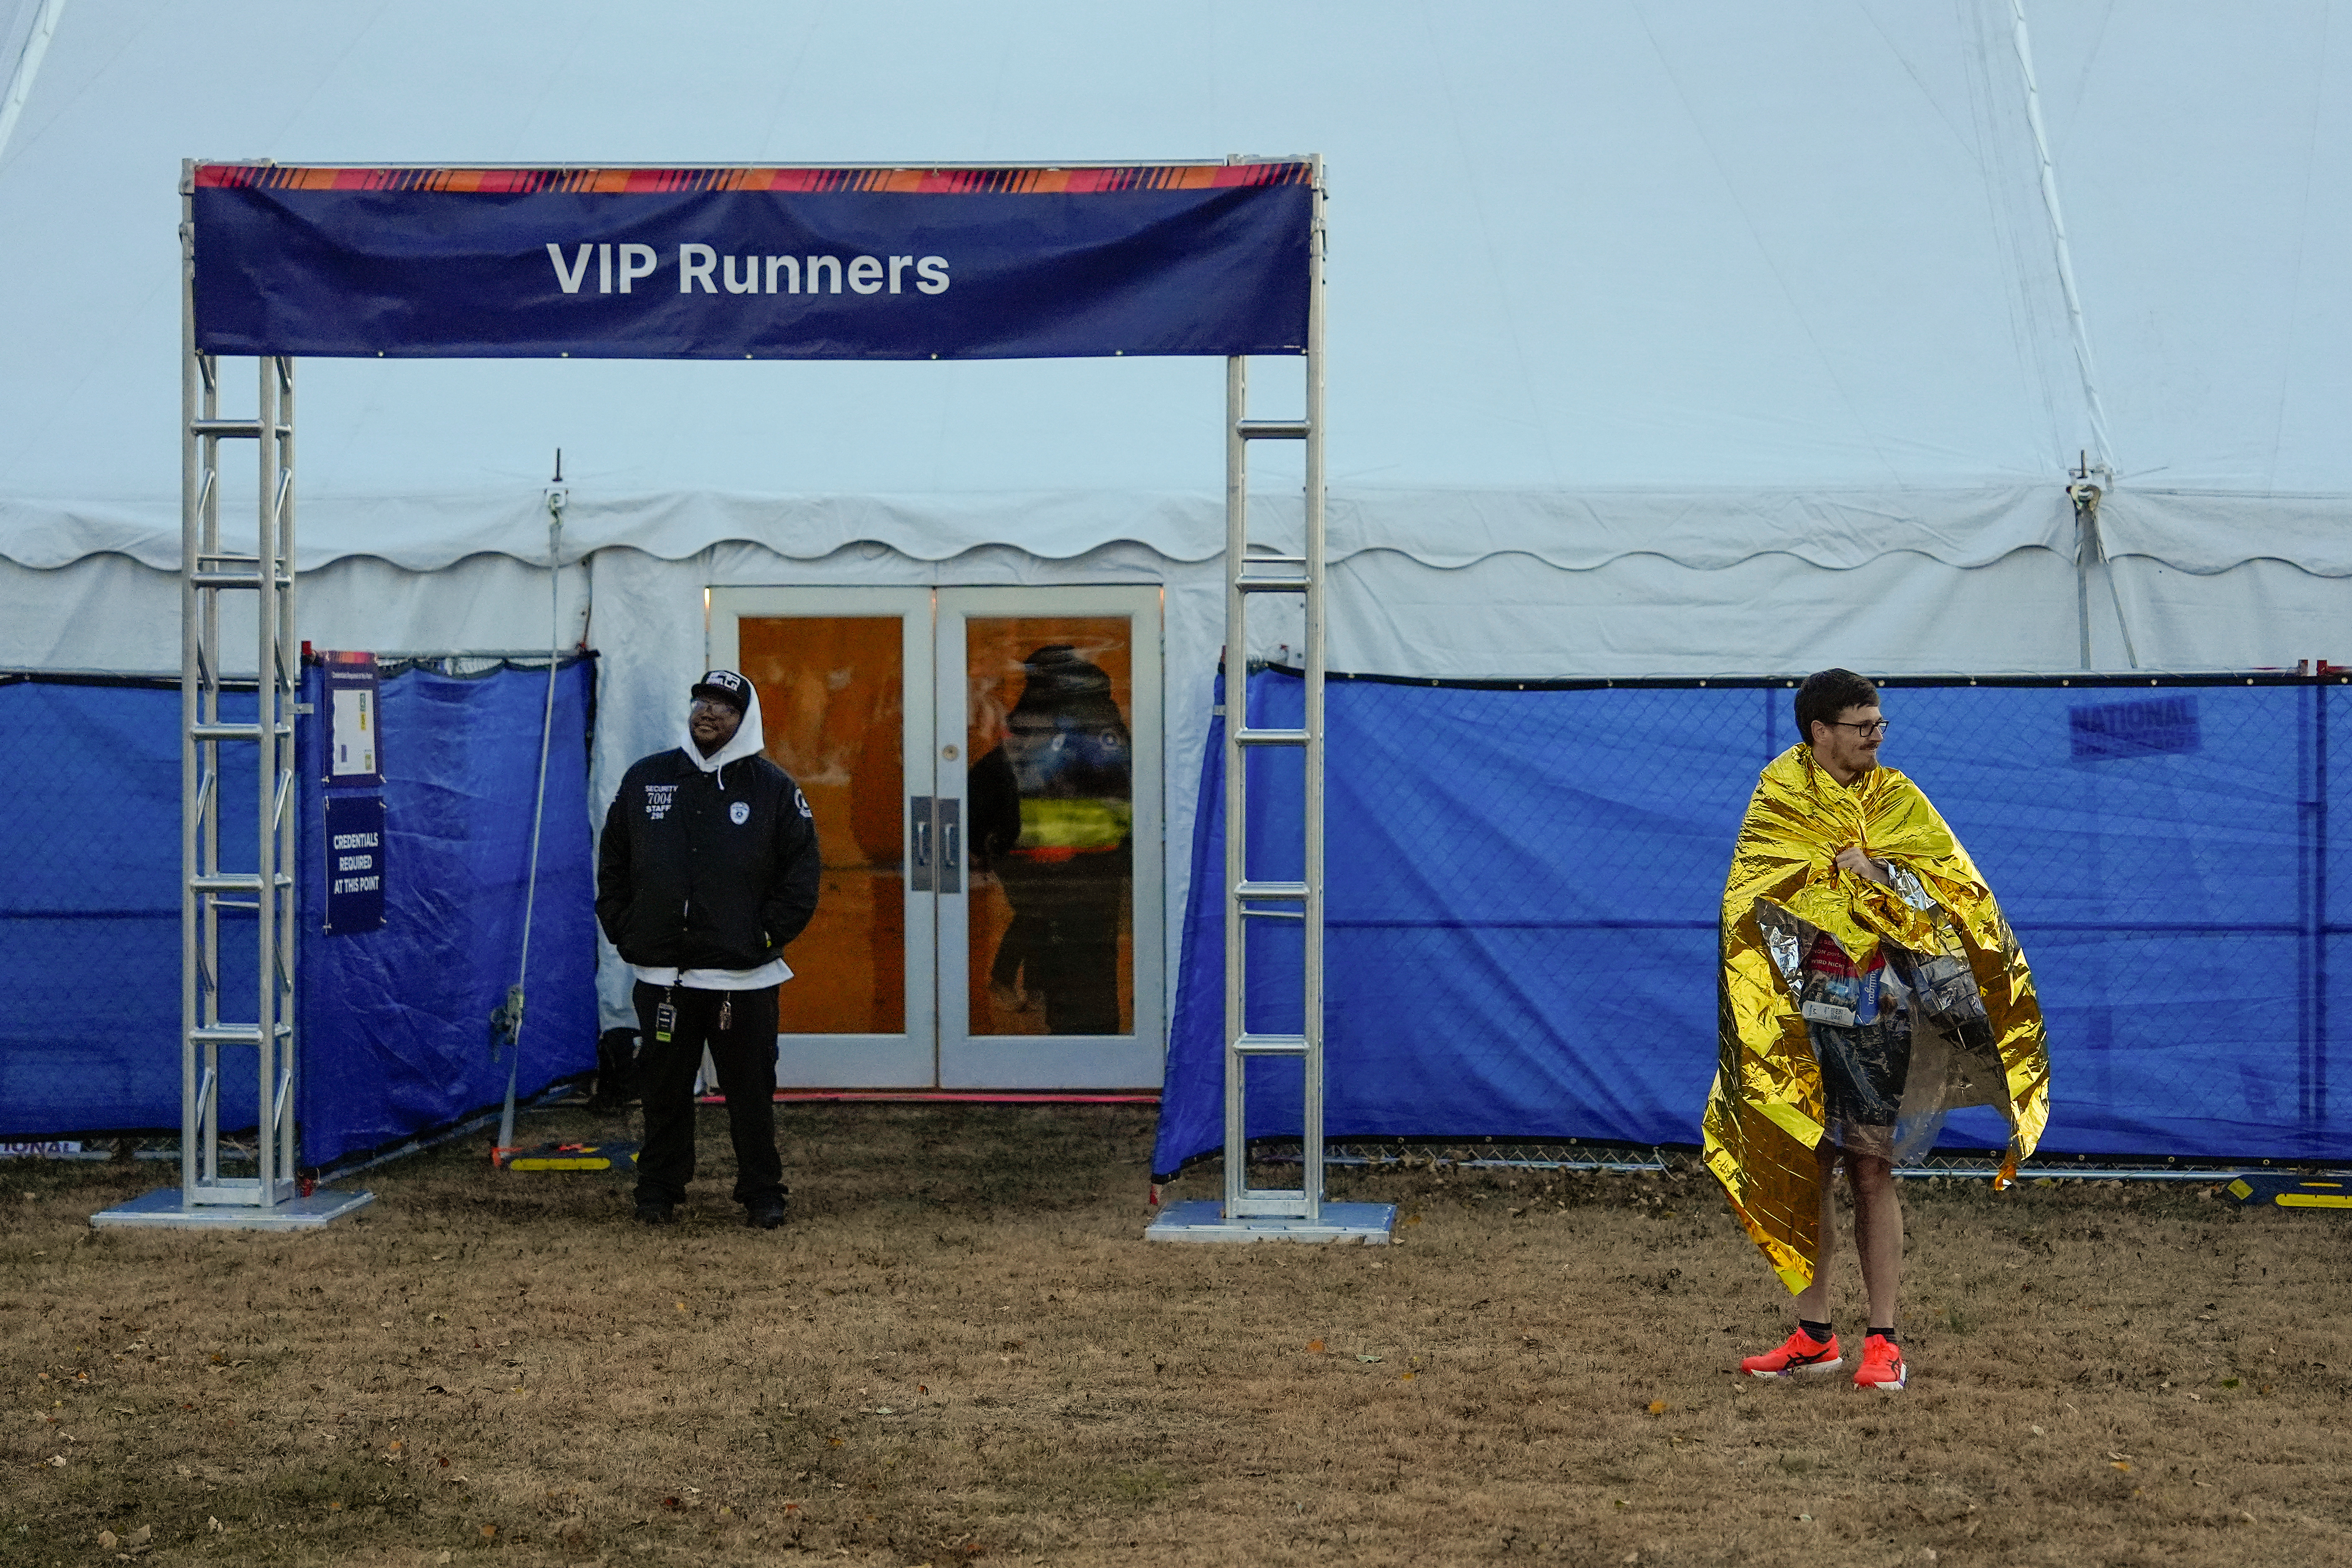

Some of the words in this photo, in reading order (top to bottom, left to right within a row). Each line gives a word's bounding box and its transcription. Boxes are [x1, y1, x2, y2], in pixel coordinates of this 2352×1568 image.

[546, 243, 657, 294] VIP
[679, 243, 951, 295] Runners
[2071, 699, 2196, 732] NATIONAL
[647, 792, 671, 804] 7004
[645, 804, 671, 813] STAFF
[334, 832, 378, 850] CREDENTIALS
[339, 854, 372, 871] REQUIRED
[334, 879, 344, 895] AT
[344, 877, 359, 893] THIS
[359, 875, 380, 892] POINT
